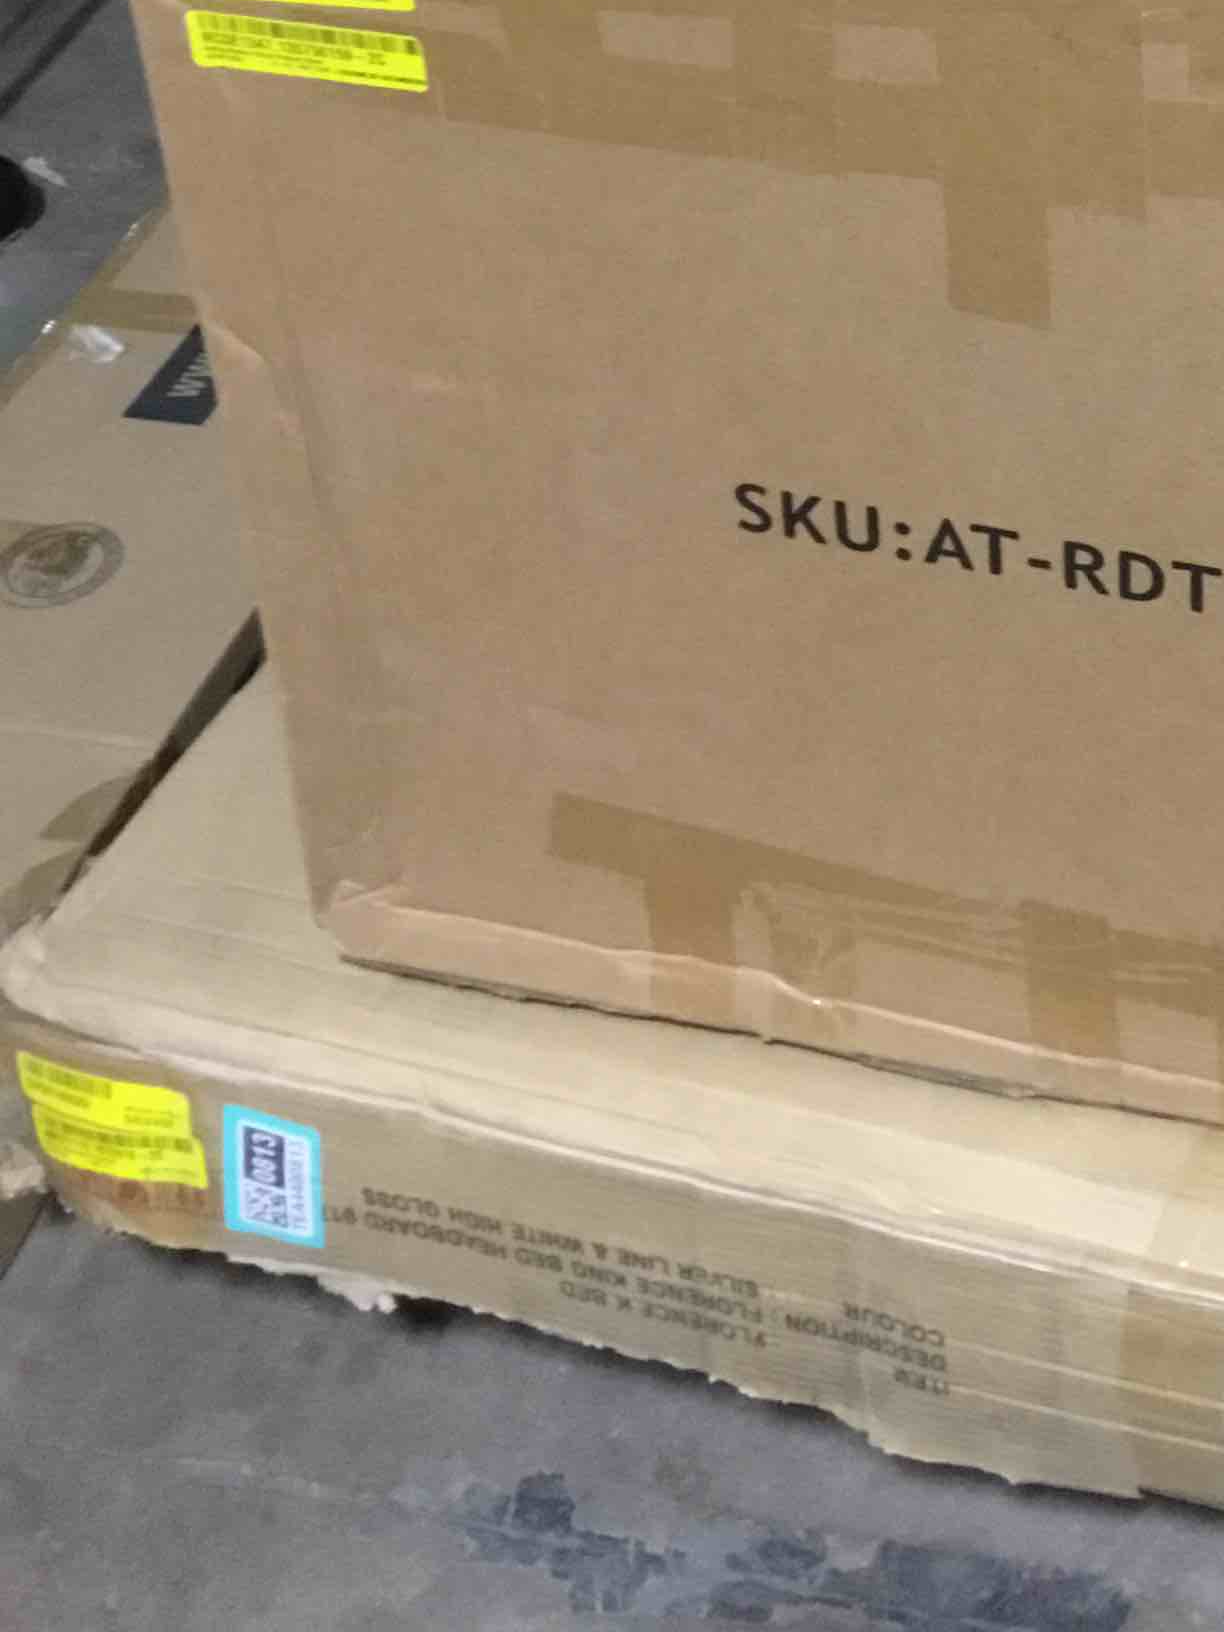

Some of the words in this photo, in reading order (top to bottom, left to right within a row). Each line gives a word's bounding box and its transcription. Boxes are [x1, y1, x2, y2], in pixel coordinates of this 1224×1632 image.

[361, 1188, 441, 1220] GLOSS
[362, 1211, 508, 1261] HEADBOARD
[447, 1208, 504, 1236] HIGH
[511, 1223, 584, 1257] WHITE
[515, 1248, 564, 1274] BED
[571, 1261, 629, 1288] KING
[619, 1249, 671, 1277] LINE
[637, 1277, 764, 1325] FLORENCE
[841, 1303, 945, 1347] COLOUR
